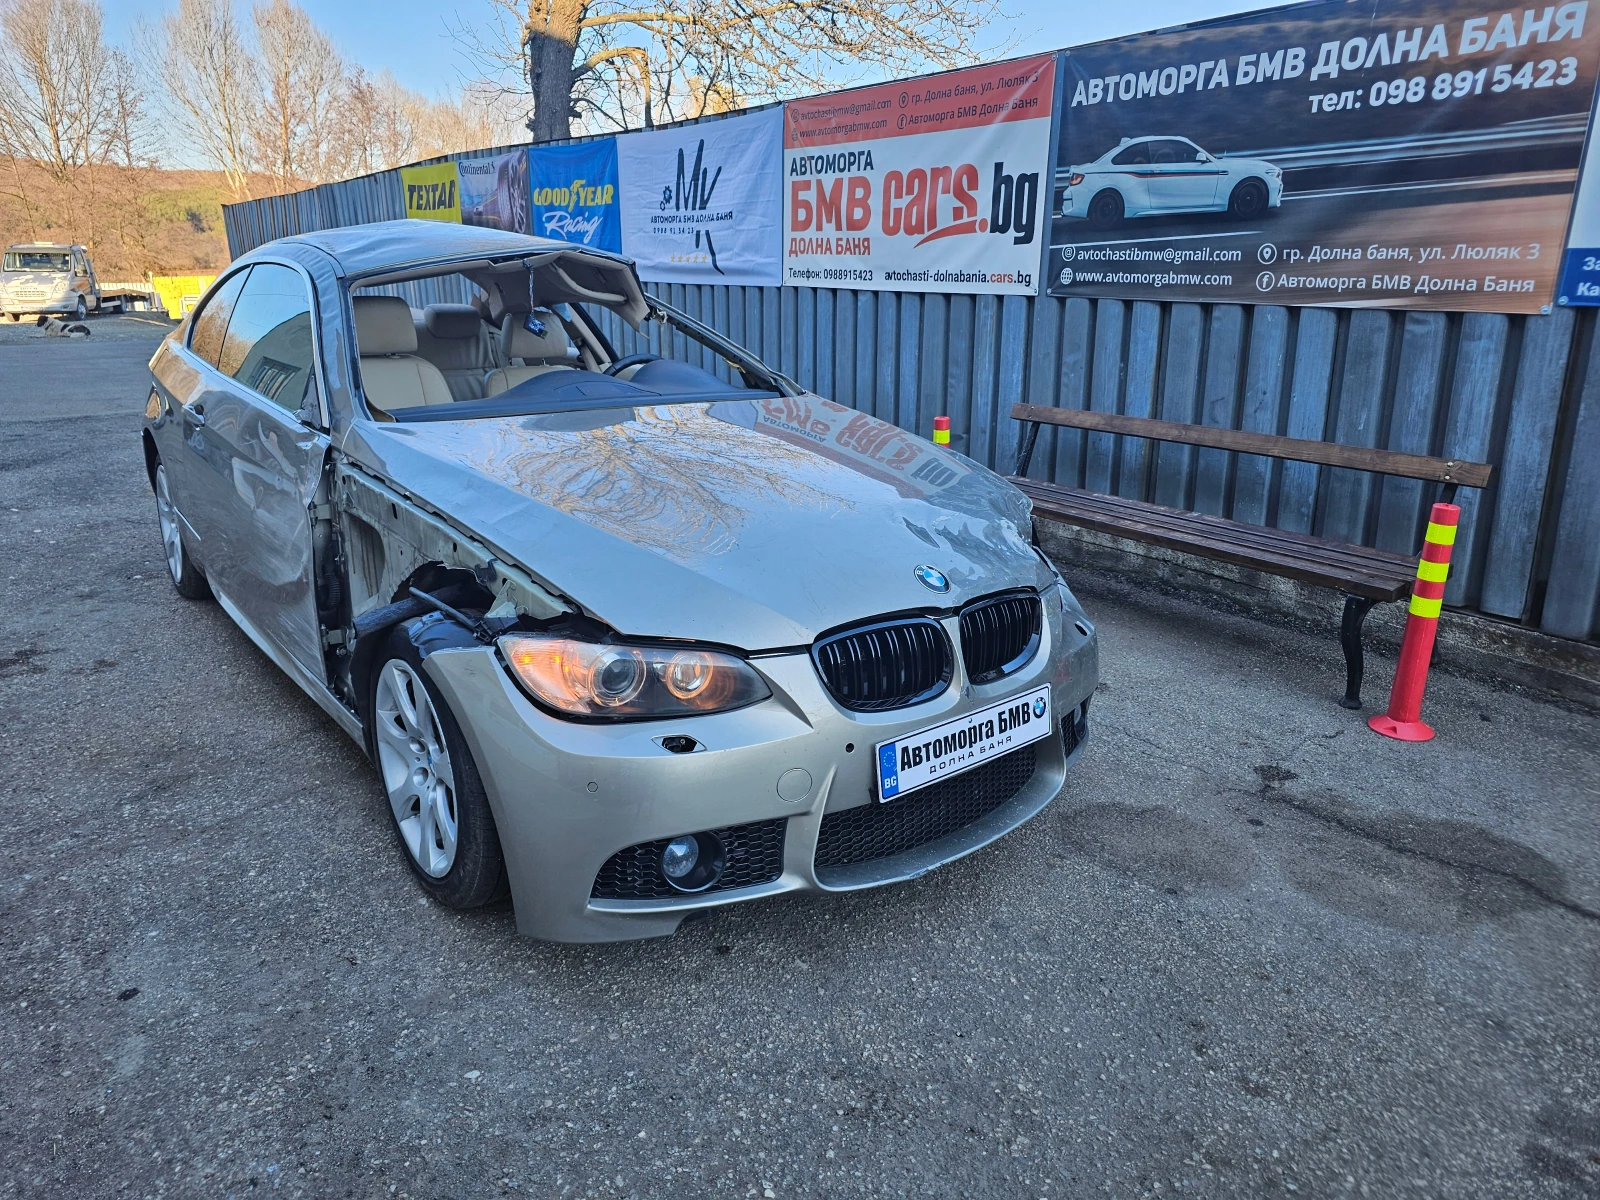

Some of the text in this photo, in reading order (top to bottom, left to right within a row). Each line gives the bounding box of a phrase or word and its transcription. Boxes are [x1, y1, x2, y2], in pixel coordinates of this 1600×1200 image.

[1071, 0, 1589, 107] АВТОМОРГА БМВ ДОЛНА БАНЯ
[924, 89, 952, 104] Долна
[954, 84, 979, 97] баня,
[980, 81, 995, 96] ул.
[996, 75, 1030, 90] Люляк
[1308, 56, 1578, 113] тел: 098 891 5423
[908, 97, 1039, 125] Автоморга БМВ Долна Баня
[799, 119, 888, 138] www.avtomorgabmw.com
[458, 161, 491, 177] Continental
[790, 150, 874, 177] АВТОМОРГА
[407, 179, 456, 211] TEXTAR
[790, 176, 872, 232] БМВ
[881, 161, 1040, 246] cars.bg
[542, 211, 604, 244] Racing
[650, 215, 682, 224] АВТОМОРГА
[716, 211, 733, 221] БАНЯ
[788, 237, 871, 258] ДОЛНА БАНЯ
[1077, 247, 1242, 265] avtochastibmw@gmail.com
[1283, 243, 1541, 264] гр. Долна баня, ул. Люляк 3
[788, 267, 874, 282] Телефон: 0988915423
[884, 268, 1032, 287] avtochasti-dolnabania.cars.bg
[1075, 270, 1233, 287] www.avtomorgabmw.com
[1277, 273, 1536, 294] Автоморга БМВ Долна Баня
[900, 701, 1031, 772] Автоморга БМВ
[929, 735, 1013, 775] ДОЛНА БАНЯ
[884, 775, 897, 789] BG
